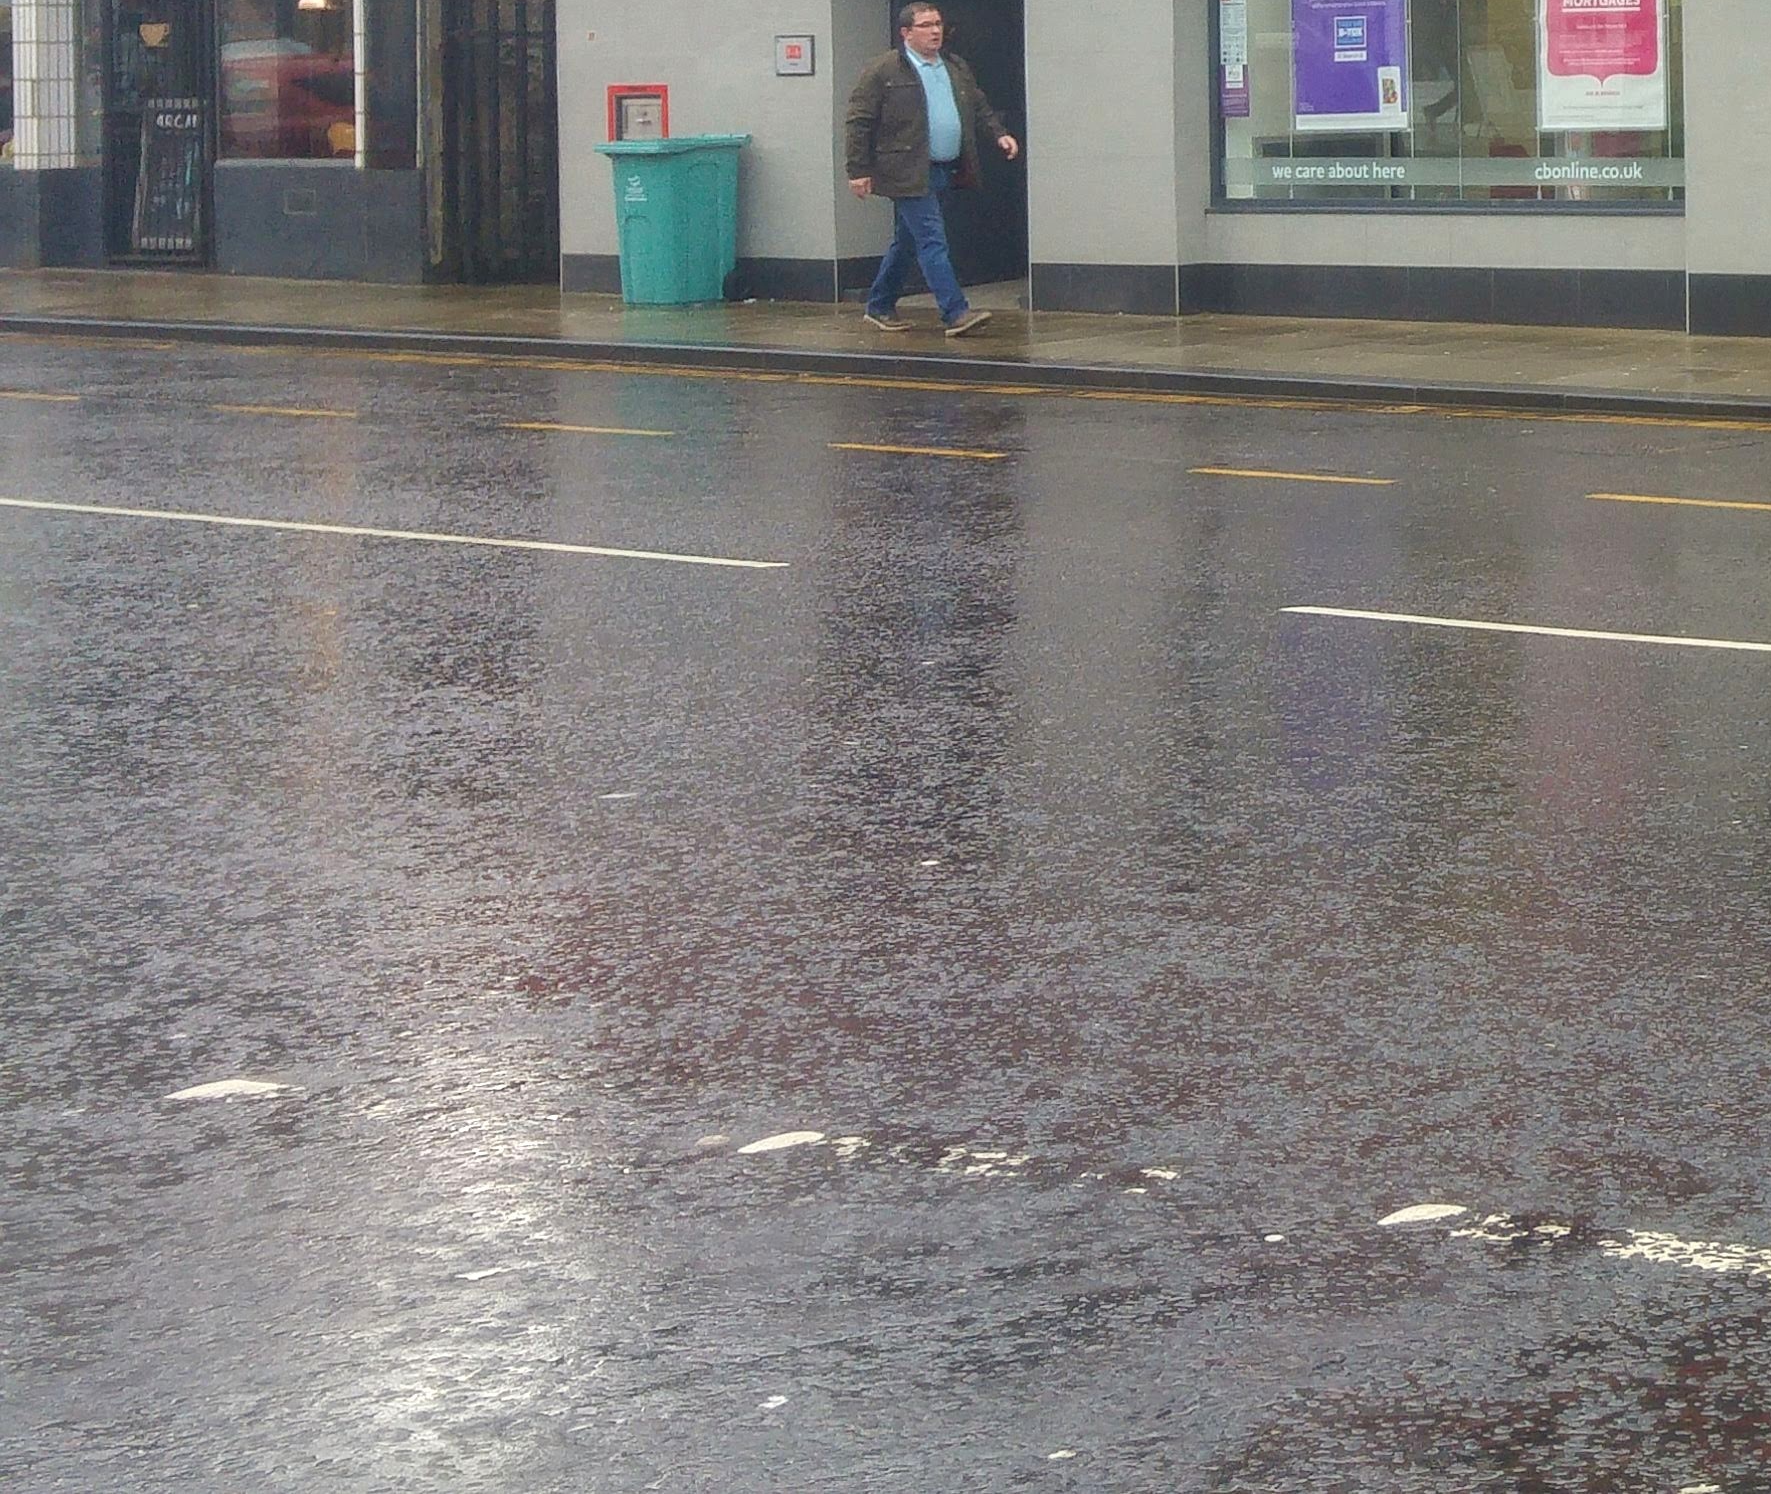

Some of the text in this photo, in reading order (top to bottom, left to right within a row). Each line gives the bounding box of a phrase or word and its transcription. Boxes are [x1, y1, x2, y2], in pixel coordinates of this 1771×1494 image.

[1272, 162, 1405, 178] we care about here
[1534, 162, 1643, 181] cbonline.co.uk
